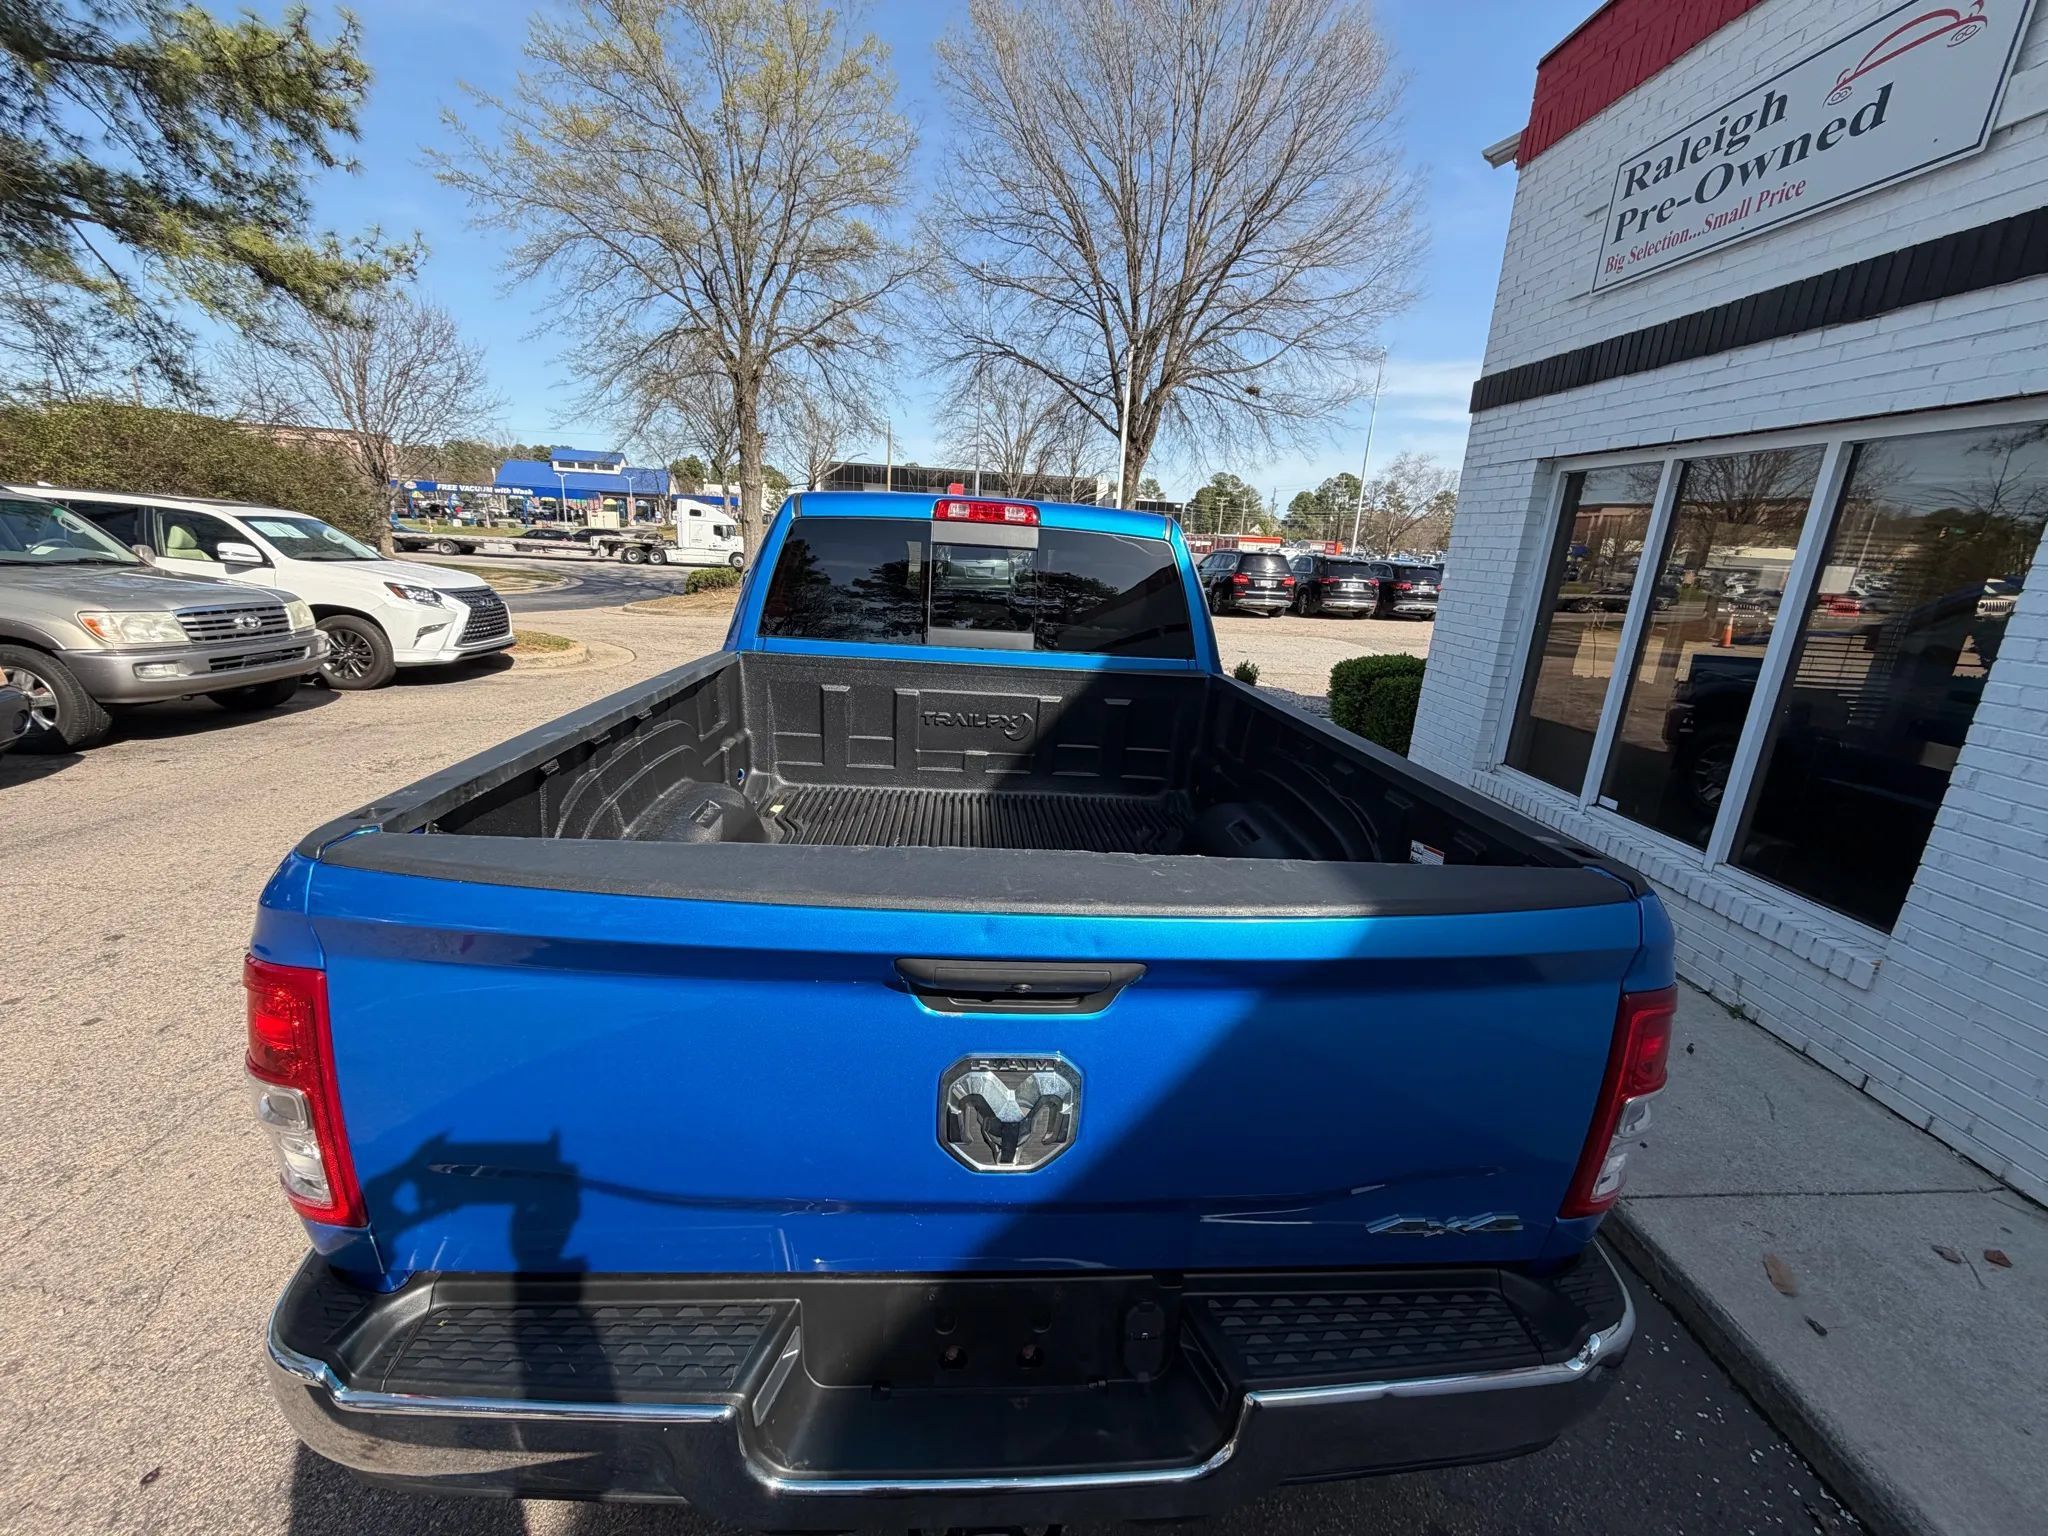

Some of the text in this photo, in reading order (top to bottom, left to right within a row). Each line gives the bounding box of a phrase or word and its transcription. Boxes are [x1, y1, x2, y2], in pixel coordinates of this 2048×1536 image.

[1610, 81, 1894, 245] Pre-Owned
[1619, 89, 1788, 201] Raleigh
[1604, 252, 1626, 275] Big
[1754, 179, 1807, 214] Price
[436, 483, 458, 491] FREE
[459, 484, 493, 493] VACUUM
[920, 710, 1020, 730] TRAILFX
[971, 1059, 1055, 1071] RAM
